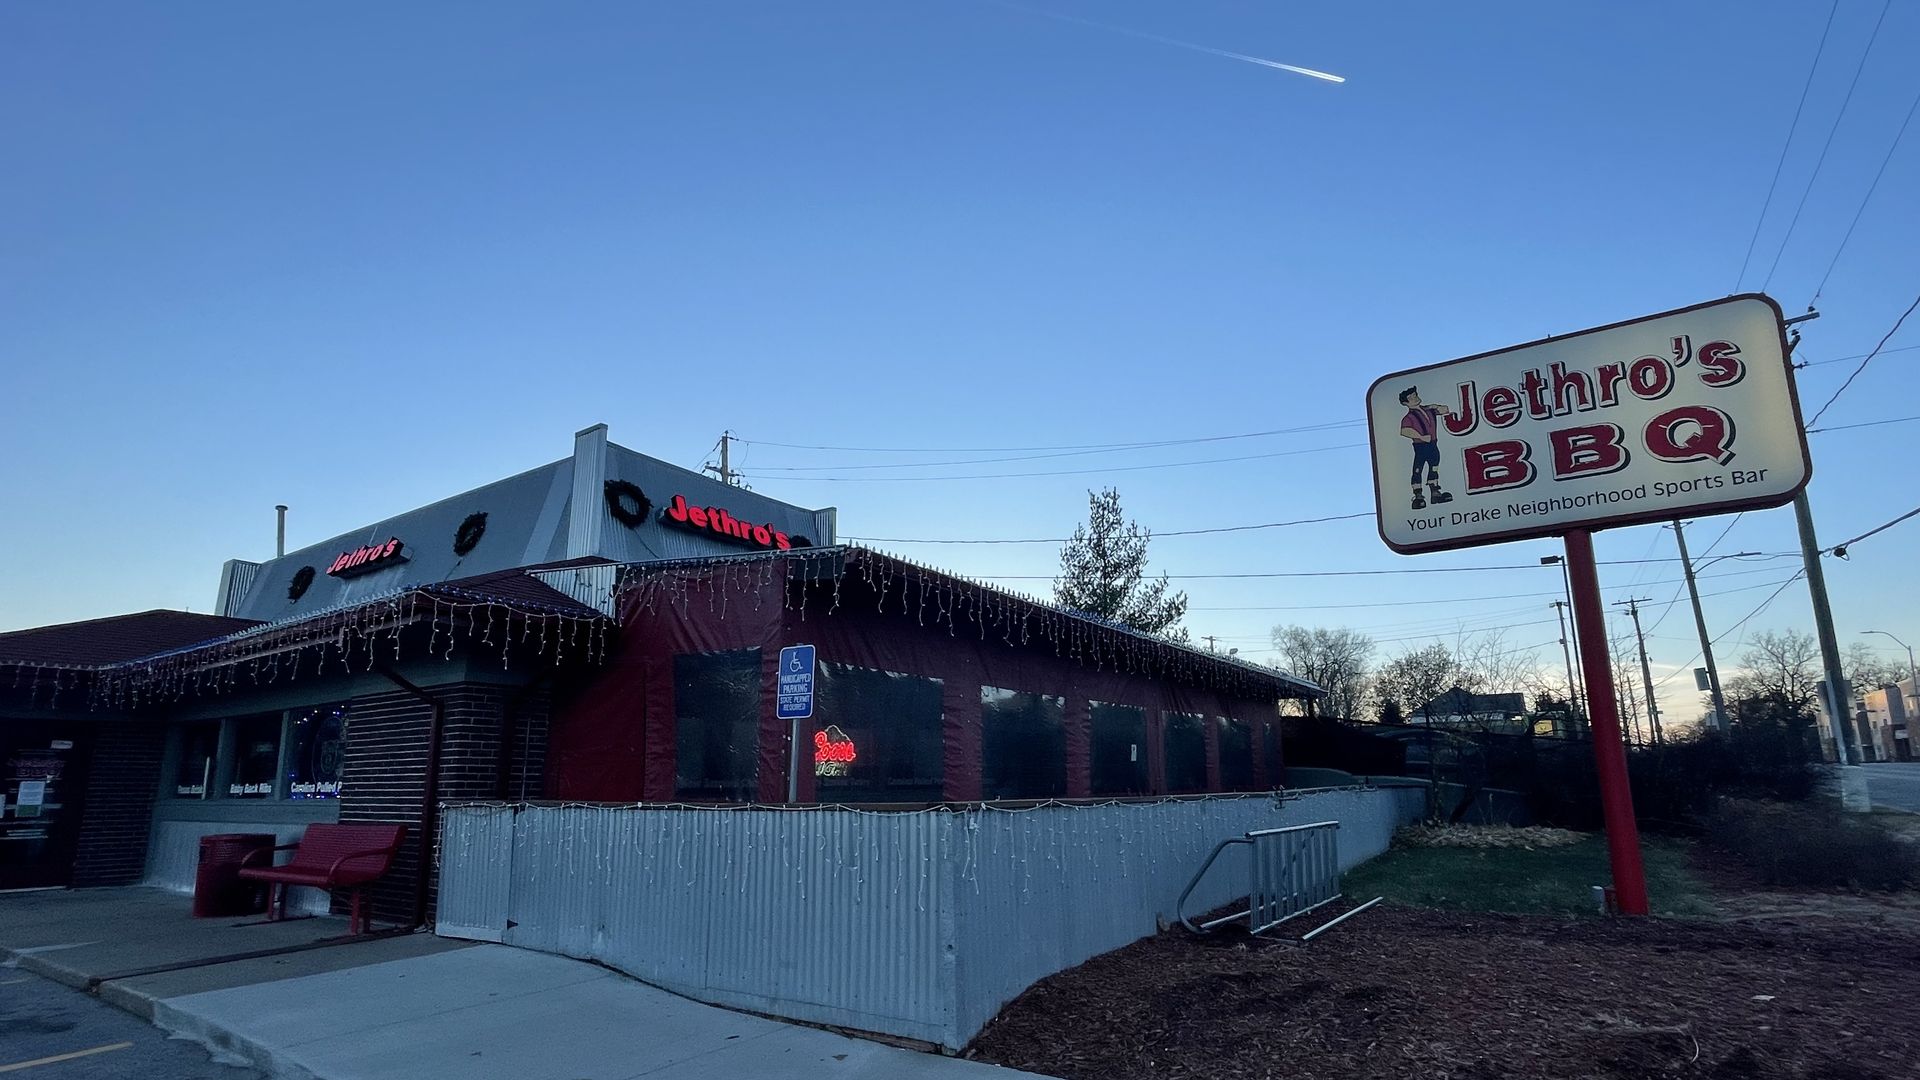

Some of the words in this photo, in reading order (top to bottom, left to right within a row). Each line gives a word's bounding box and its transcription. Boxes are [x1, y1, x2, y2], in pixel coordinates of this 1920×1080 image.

[1441, 334, 1747, 437] Jethro's
[1407, 516, 1445, 531] Your
[1451, 508, 1501, 525] Drake
[1507, 484, 1647, 518] Neighborhood
[1654, 475, 1724, 497] Sports
[1731, 468, 1768, 486] Bar
[668, 494, 792, 550] Jethro's
[326, 538, 399, 574] Jethro's
[780, 673, 811, 684] HANDICAPPED
[783, 683, 808, 694] PARKING
[780, 696, 793, 704] STATE
[793, 695, 810, 703] PERMIT
[230, 784, 244, 796] Baby
[244, 783, 258, 794] Back
[291, 782, 315, 792] Carolina
[316, 781, 336, 792] Pulled
